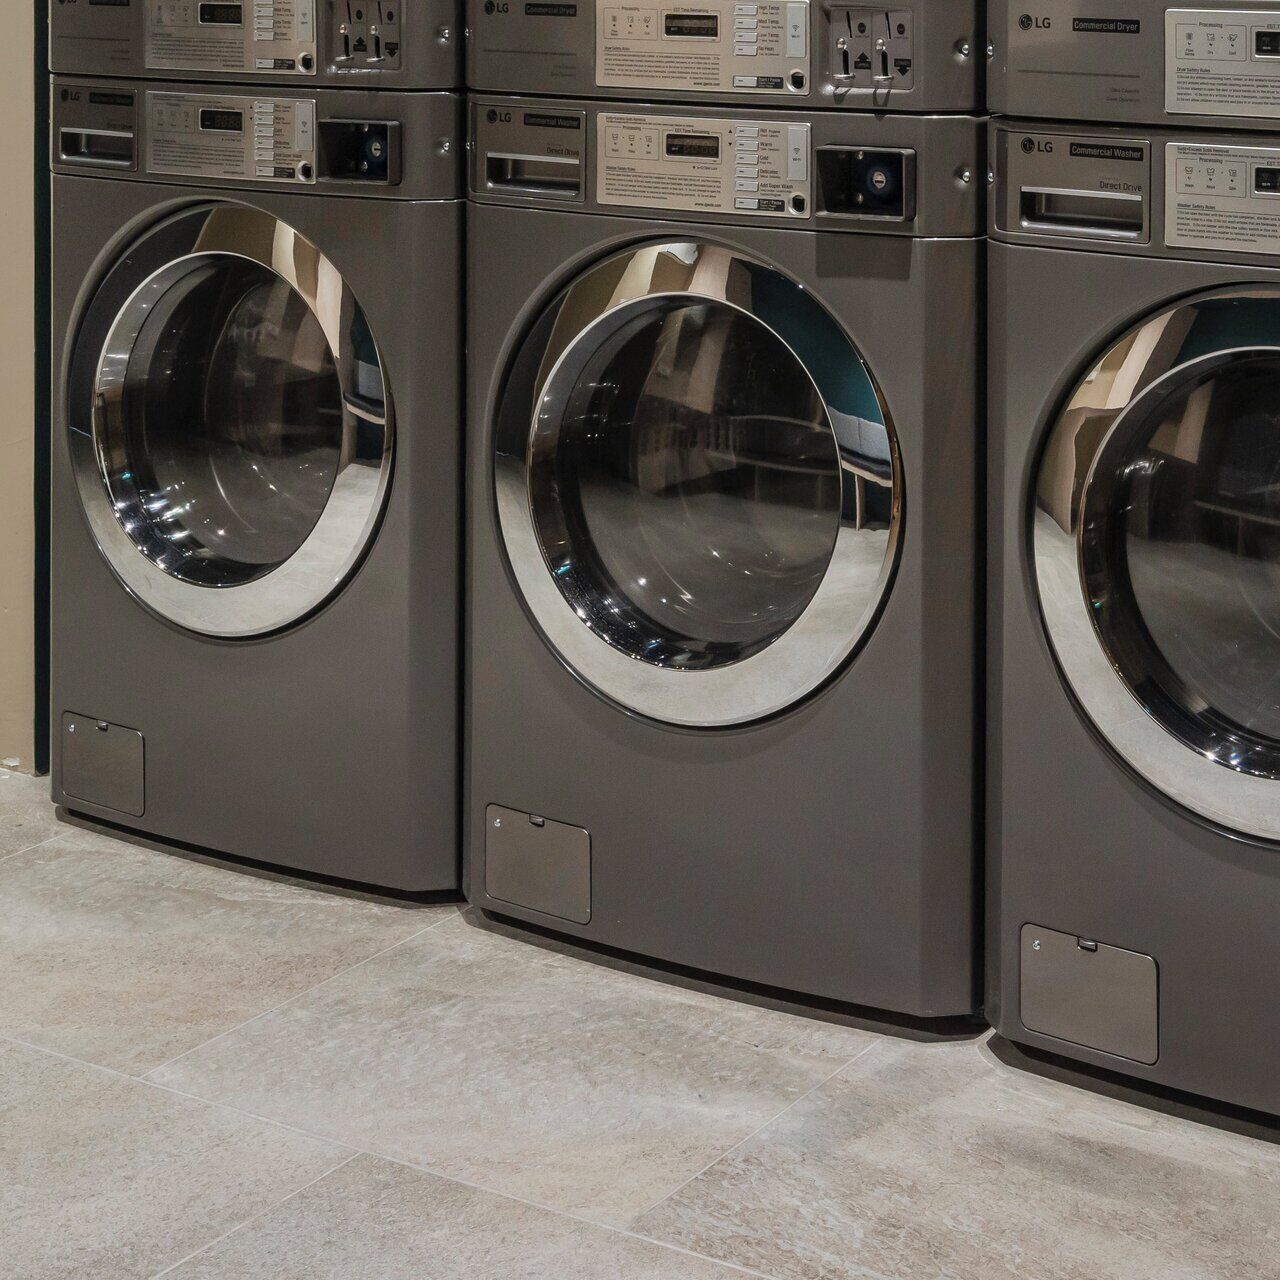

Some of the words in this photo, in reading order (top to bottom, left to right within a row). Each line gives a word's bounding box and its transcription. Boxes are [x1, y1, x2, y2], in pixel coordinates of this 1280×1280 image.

[1074, 20, 1116, 30] Commercial
[1117, 21, 1138, 32] Dryer
[1072, 146, 1114, 156] Commercial
[1114, 149, 1142, 159] Washer
[1099, 181, 1121, 190] Direct
[1122, 182, 1142, 192] Drive
